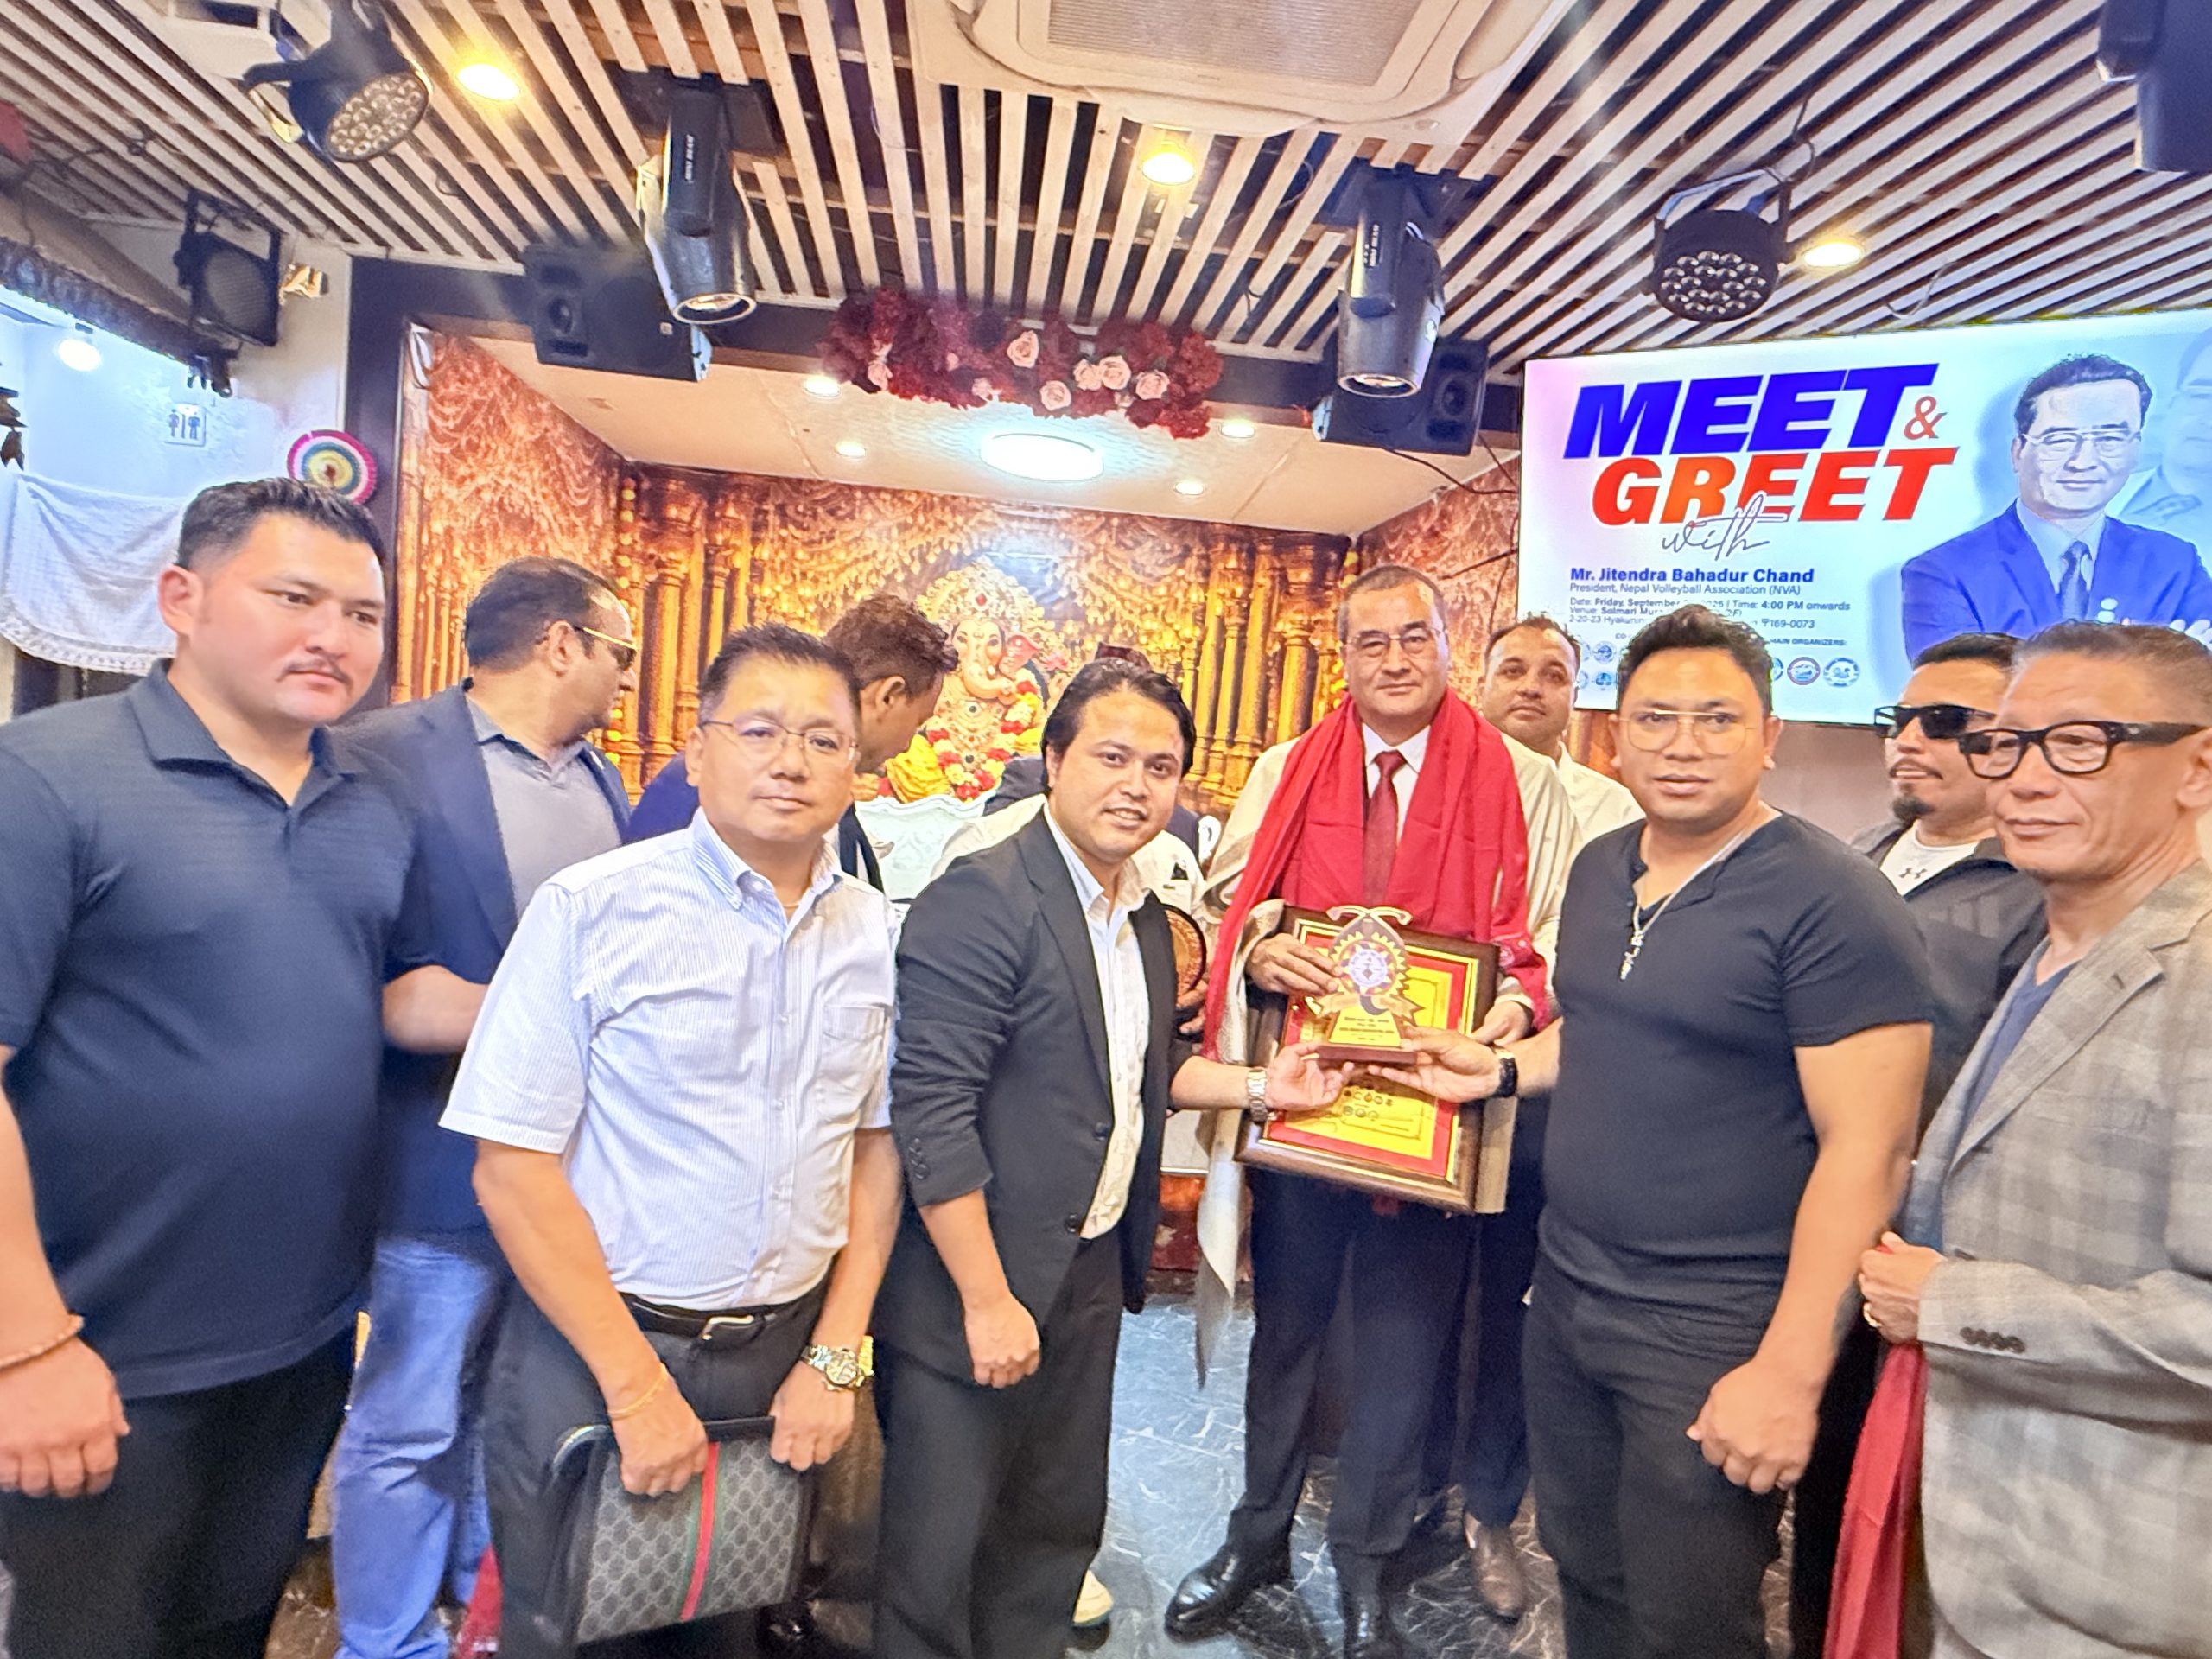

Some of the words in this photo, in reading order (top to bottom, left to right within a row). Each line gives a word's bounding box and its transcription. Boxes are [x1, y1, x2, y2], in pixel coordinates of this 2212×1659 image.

[1563, 363, 1940, 458] MEET
[1904, 396, 1948, 441] &
[1592, 446, 1961, 525] GREET
[1661, 493, 1788, 561] with
[1570, 568, 1595, 581] Mr.
[1599, 568, 1667, 582] Jitendra
[1672, 568, 1749, 582] Bahadur
[1753, 569, 1815, 582] Chand
[1570, 582, 1618, 593] President,
[1620, 583, 1649, 594] Nepal
[1652, 584, 1701, 595] Volleyball
[1704, 584, 1766, 594] Association
[1769, 585, 1801, 596] (NVA)
[1595, 597, 1624, 607] Friday,
[1627, 598, 1680, 608] September
[1761, 601, 1784, 609] 4:00
[1786, 601, 1804, 610] PM
[1806, 602, 1851, 611] onwards
